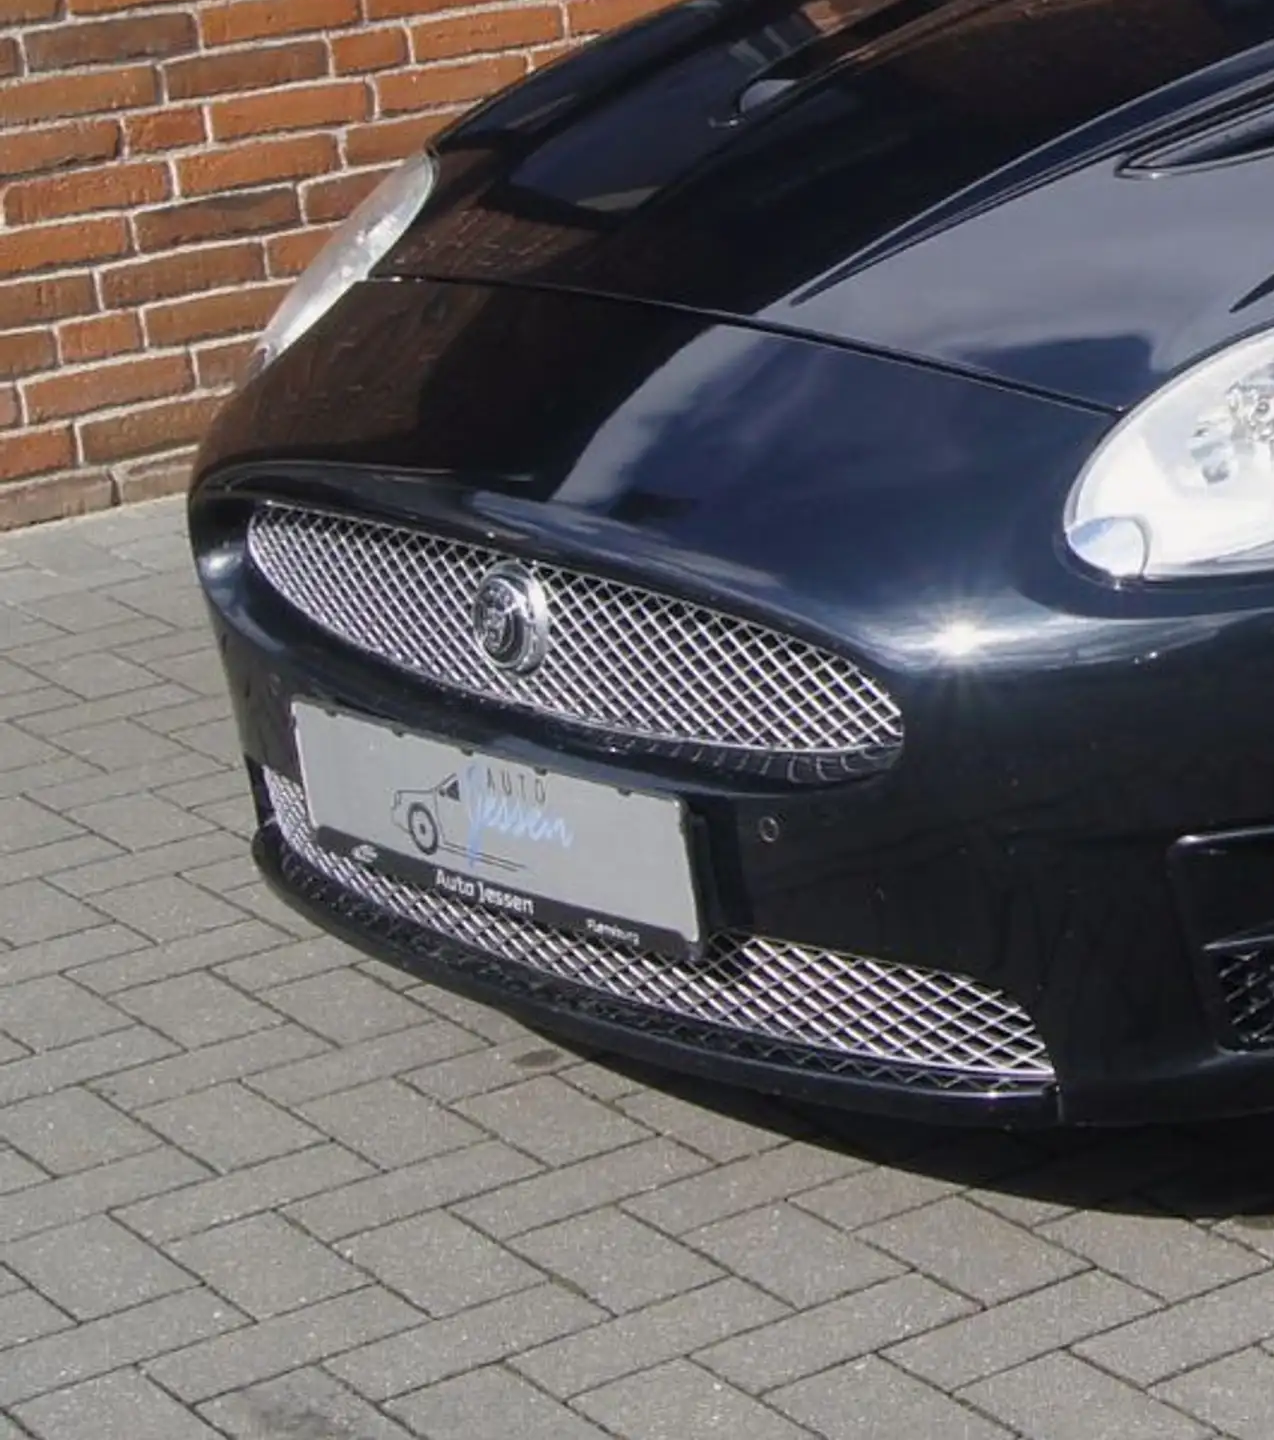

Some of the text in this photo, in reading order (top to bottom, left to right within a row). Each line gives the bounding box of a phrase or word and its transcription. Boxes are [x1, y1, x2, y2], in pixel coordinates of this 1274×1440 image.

[486, 768, 547, 804] AUTO
[465, 763, 575, 868] Jessen
[435, 868, 535, 915] Auto Jessen
